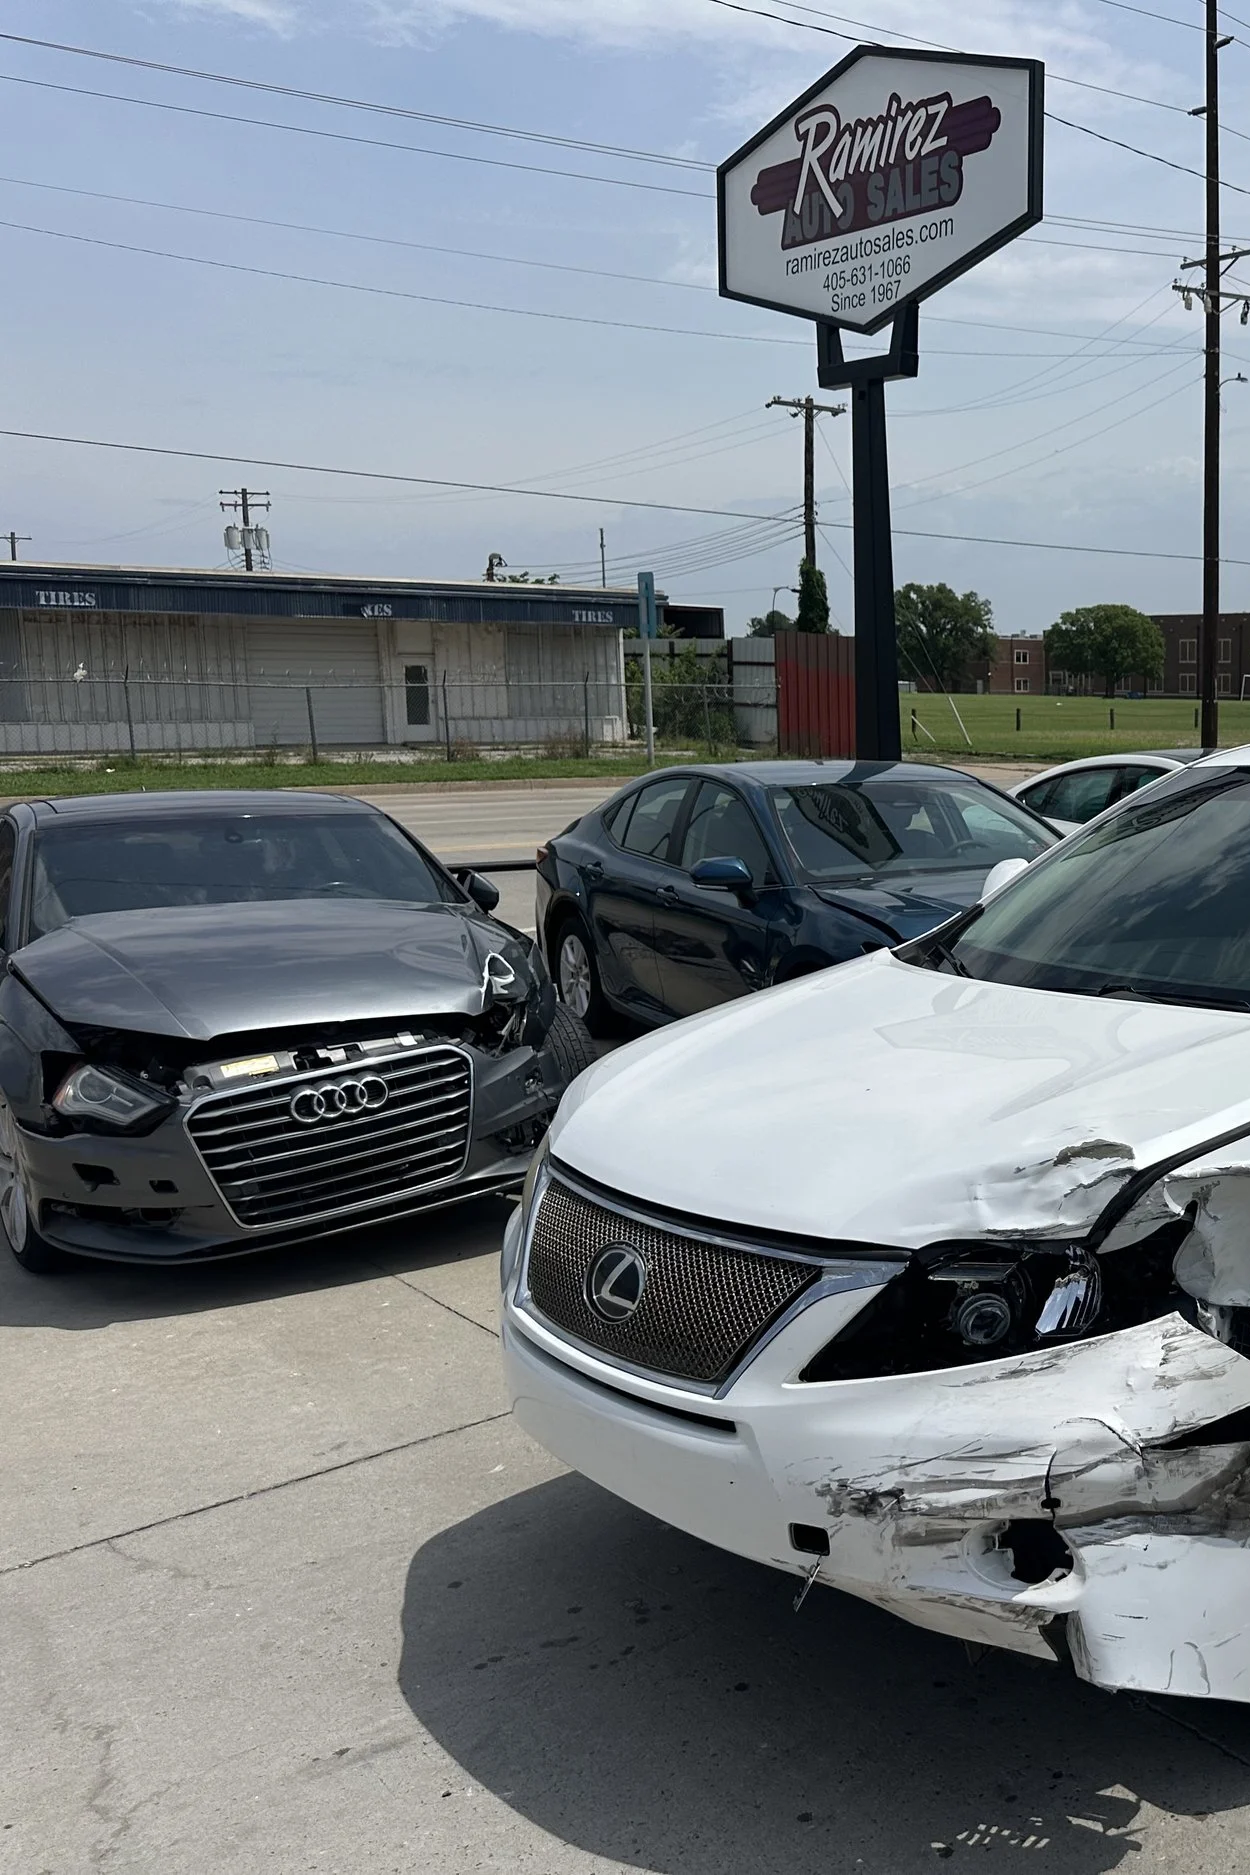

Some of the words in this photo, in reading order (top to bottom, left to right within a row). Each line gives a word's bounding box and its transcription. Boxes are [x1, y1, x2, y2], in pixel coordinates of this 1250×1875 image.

[794, 100, 949, 218] Ramirez
[783, 182, 854, 245] AUTO
[867, 150, 960, 221] SALES
[785, 217, 954, 276] ramirezautosales.com
[823, 255, 911, 292] 405-631-1066
[831, 293, 866, 313] Since
[870, 280, 902, 304] 1967
[35, 591, 96, 606] TIRES
[572, 610, 613, 622] TIRES
